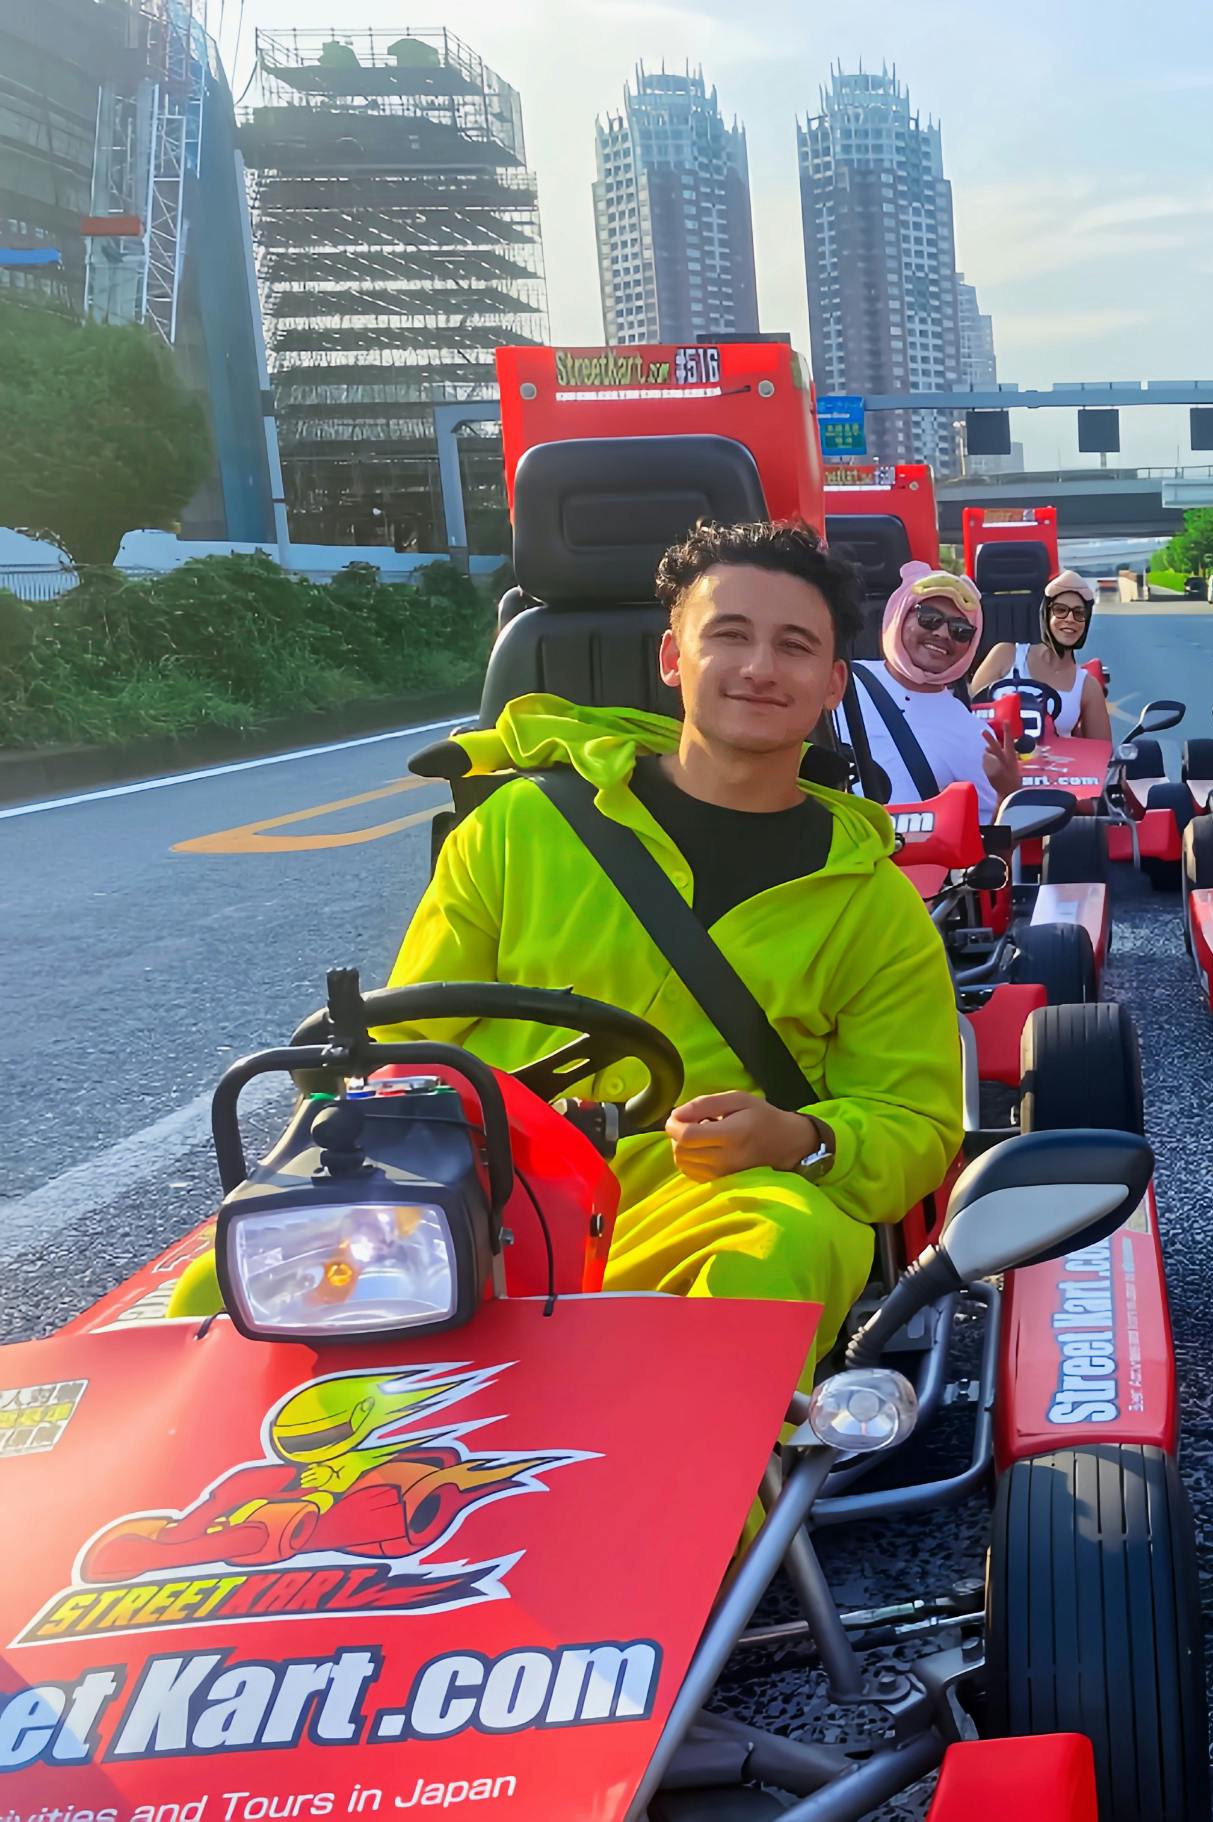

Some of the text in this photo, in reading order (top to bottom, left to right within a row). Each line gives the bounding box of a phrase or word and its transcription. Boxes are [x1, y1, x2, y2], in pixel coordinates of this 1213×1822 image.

[674, 348, 719, 385] #516
[1048, 1331, 1119, 1425] Street
[131, 1795, 208, 1822] and
[222, 1791, 334, 1821] Tours
[348, 1784, 383, 1813] in
[395, 1775, 517, 1811] Japan
